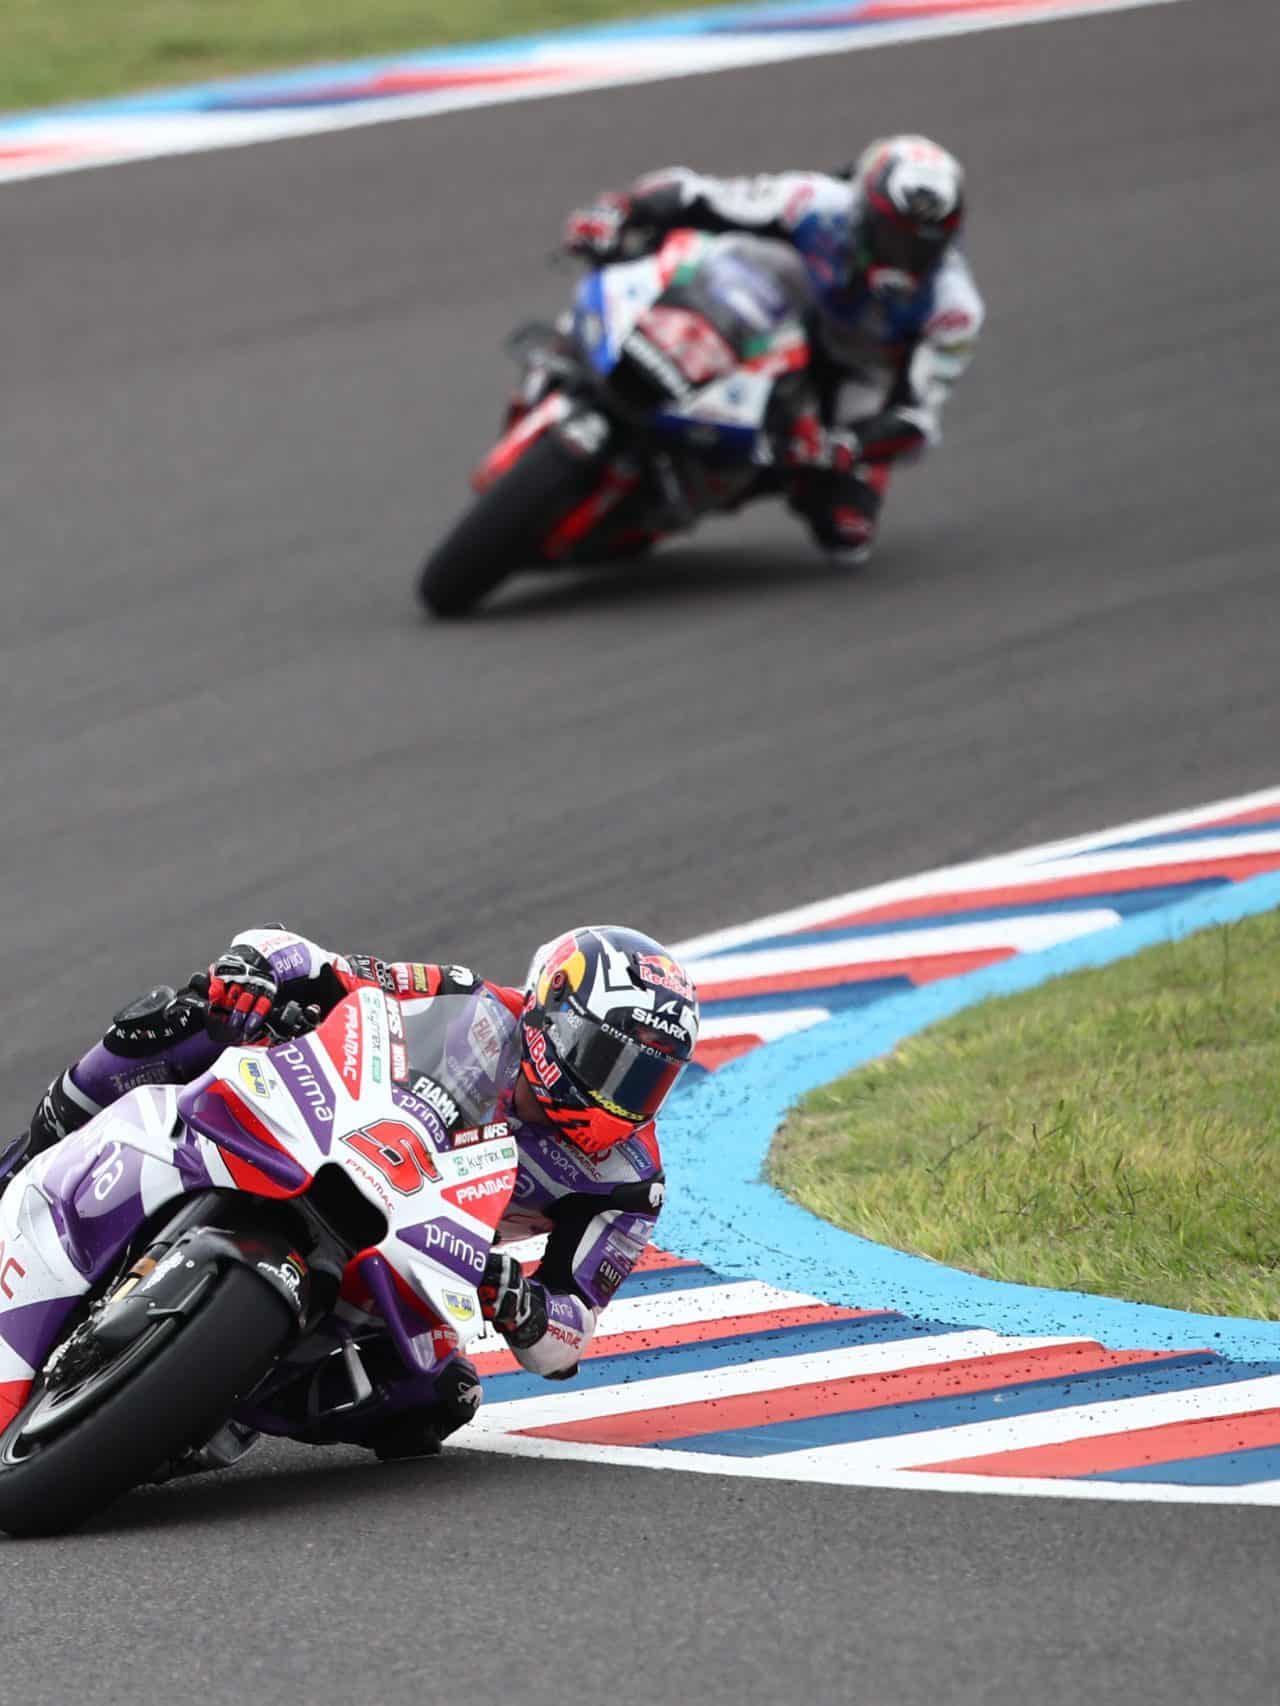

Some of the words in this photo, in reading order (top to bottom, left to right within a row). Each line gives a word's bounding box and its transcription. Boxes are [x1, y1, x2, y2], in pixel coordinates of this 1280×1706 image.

[342, 1003, 359, 1081] PRAMAC
[631, 1007, 688, 1042] SHARK
[275, 1042, 334, 1122] prima
[411, 1076, 459, 1127] FIAMM
[399, 1094, 446, 1144] prima
[455, 1174, 513, 1205] PRAMAC
[423, 1223, 488, 1273] prima
